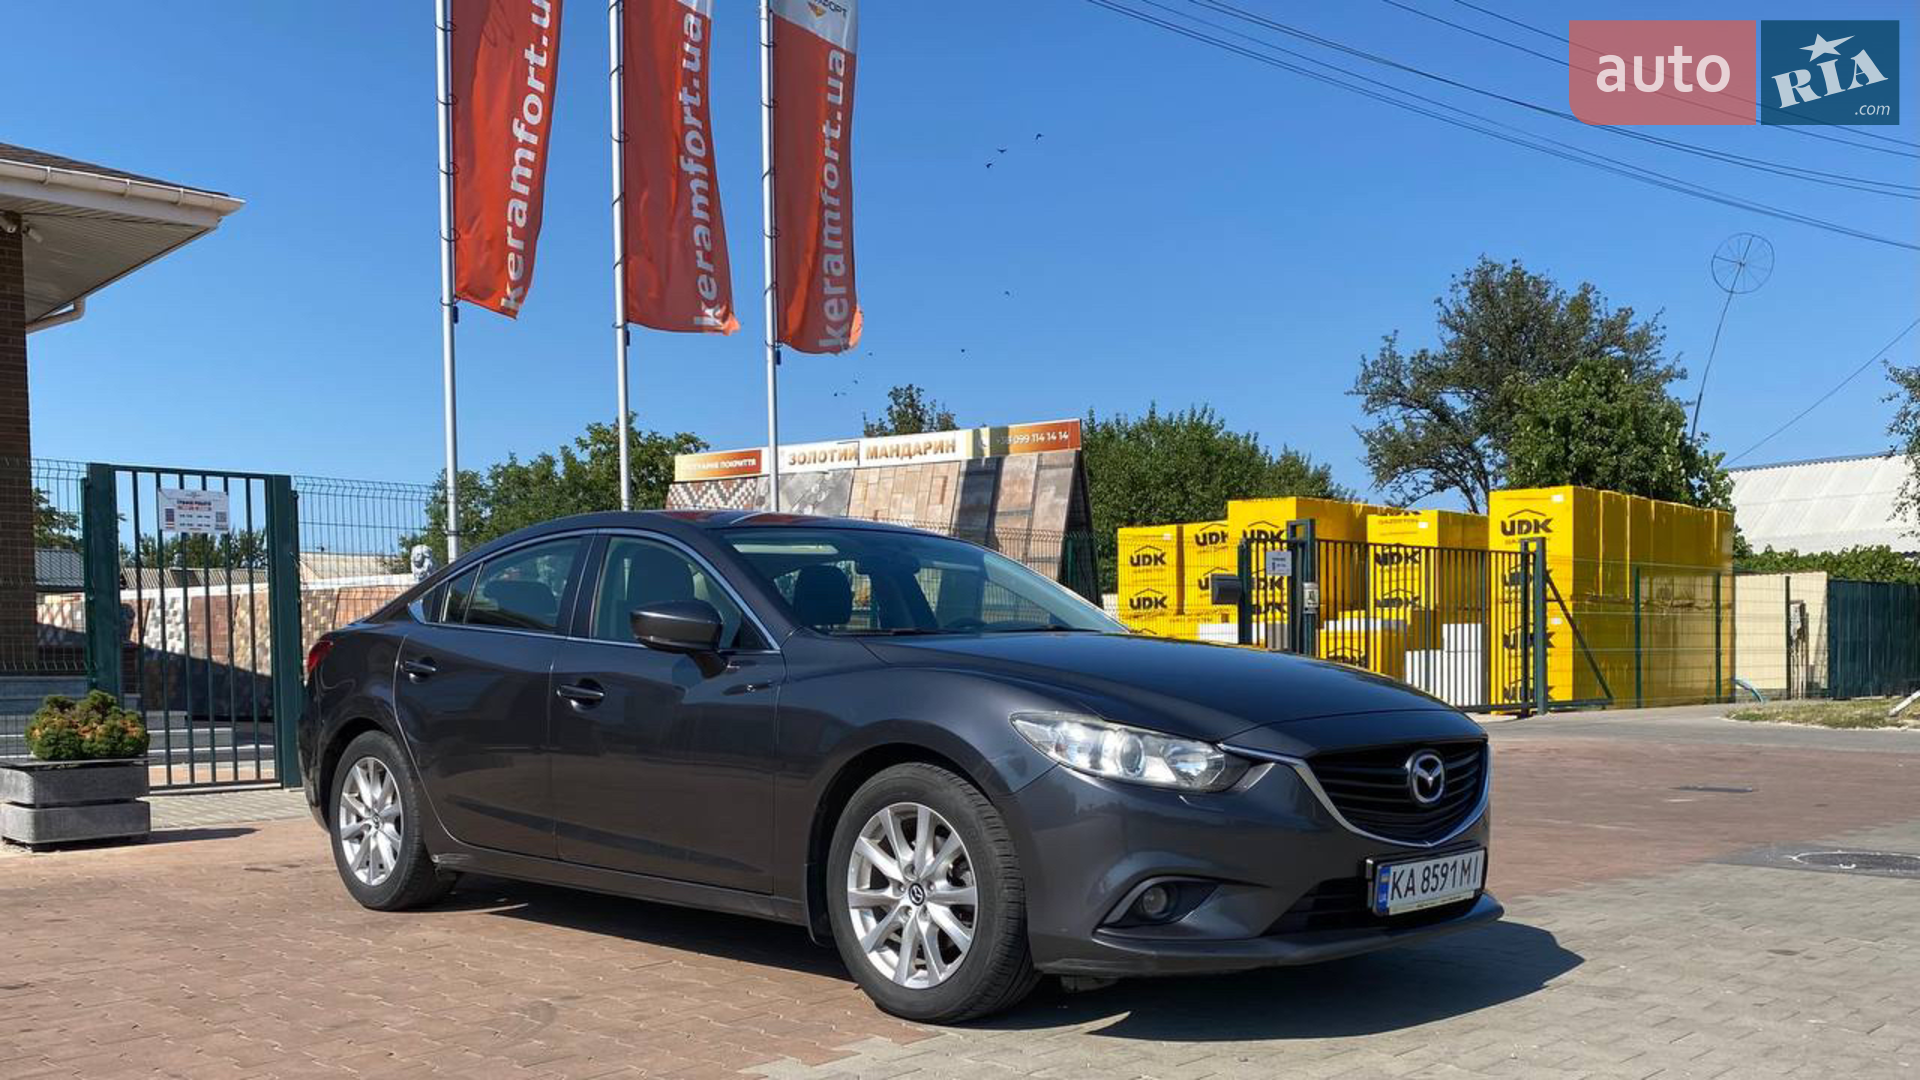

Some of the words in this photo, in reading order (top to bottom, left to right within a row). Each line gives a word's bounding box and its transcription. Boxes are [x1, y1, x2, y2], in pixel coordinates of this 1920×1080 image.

[679, 13, 725, 327] keramfort.ua
[818, 50, 848, 350] keramfort.ua
[1013, 434, 1030, 445] 099
[1031, 433, 1046, 443] 114
[1047, 431, 1057, 442] 14
[1058, 431, 1069, 441] 14
[865, 440, 956, 459] МАНДАРИН
[1501, 518, 1553, 536] UDK
[1130, 552, 1166, 567] UDK
[1129, 595, 1167, 610] UDK
[1391, 867, 1415, 901] KA
[1421, 861, 1457, 894] 8591
[1459, 855, 1479, 887] MI
